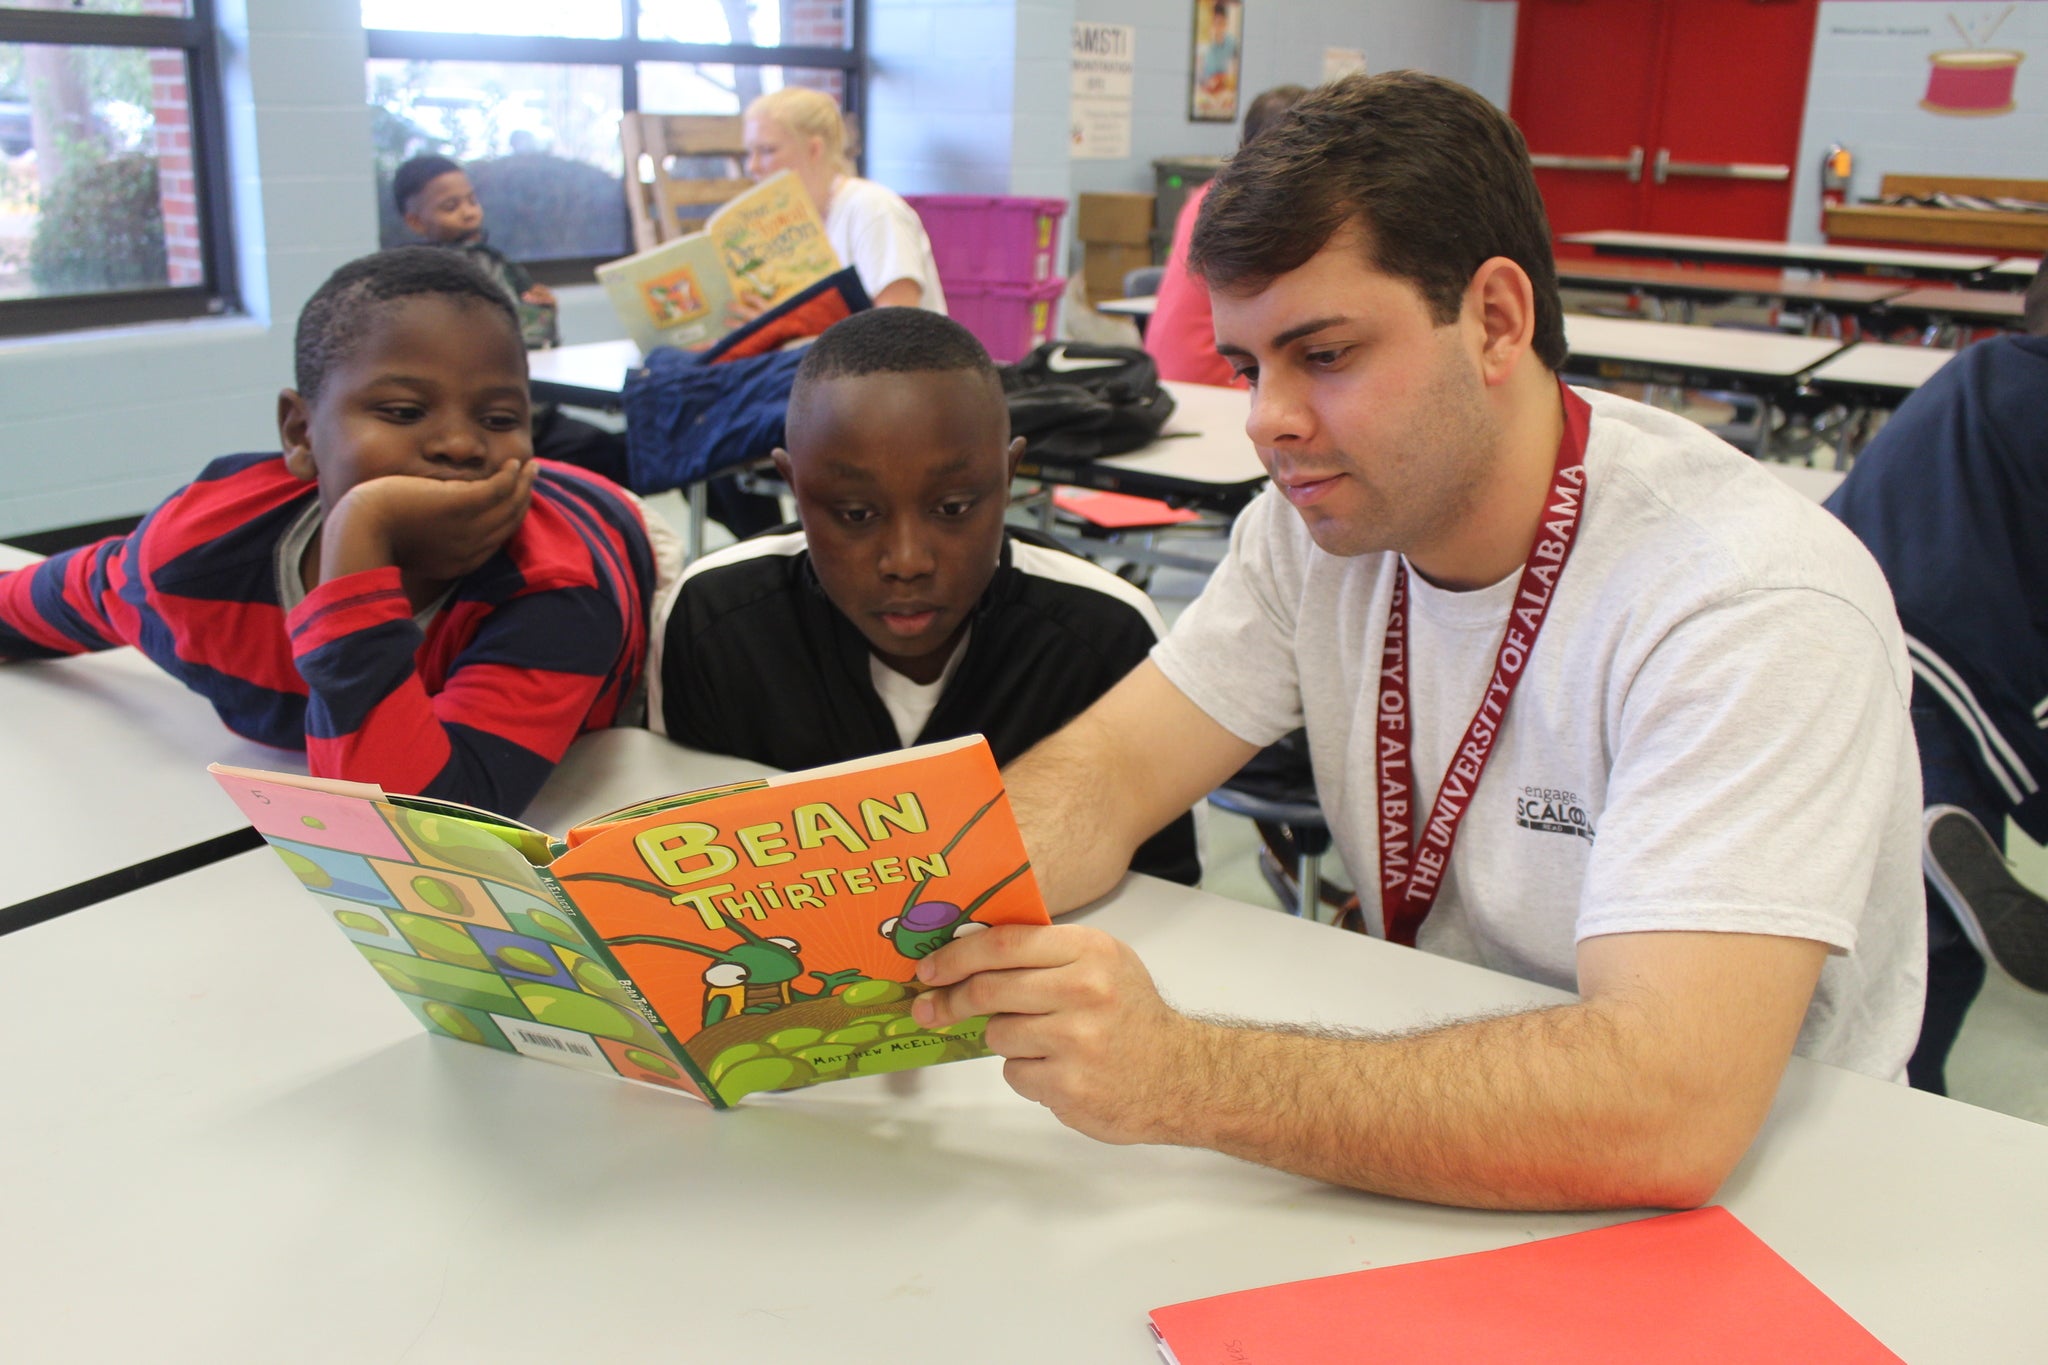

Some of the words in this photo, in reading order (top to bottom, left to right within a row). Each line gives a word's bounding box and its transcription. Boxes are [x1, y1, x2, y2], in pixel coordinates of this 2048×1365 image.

[1380, 690, 1405, 730] OF
[1404, 848, 1446, 901] THE
[1426, 670, 1510, 847] UNIVERSITY
[1502, 628, 1530, 674] OF
[1516, 464, 1585, 632] ALABAMA
[1380, 736, 1409, 890] ALABAMA
[1525, 786, 1577, 805] engage
[633, 792, 929, 886] BEAN
[814, 1047, 882, 1066] MATTHEW
